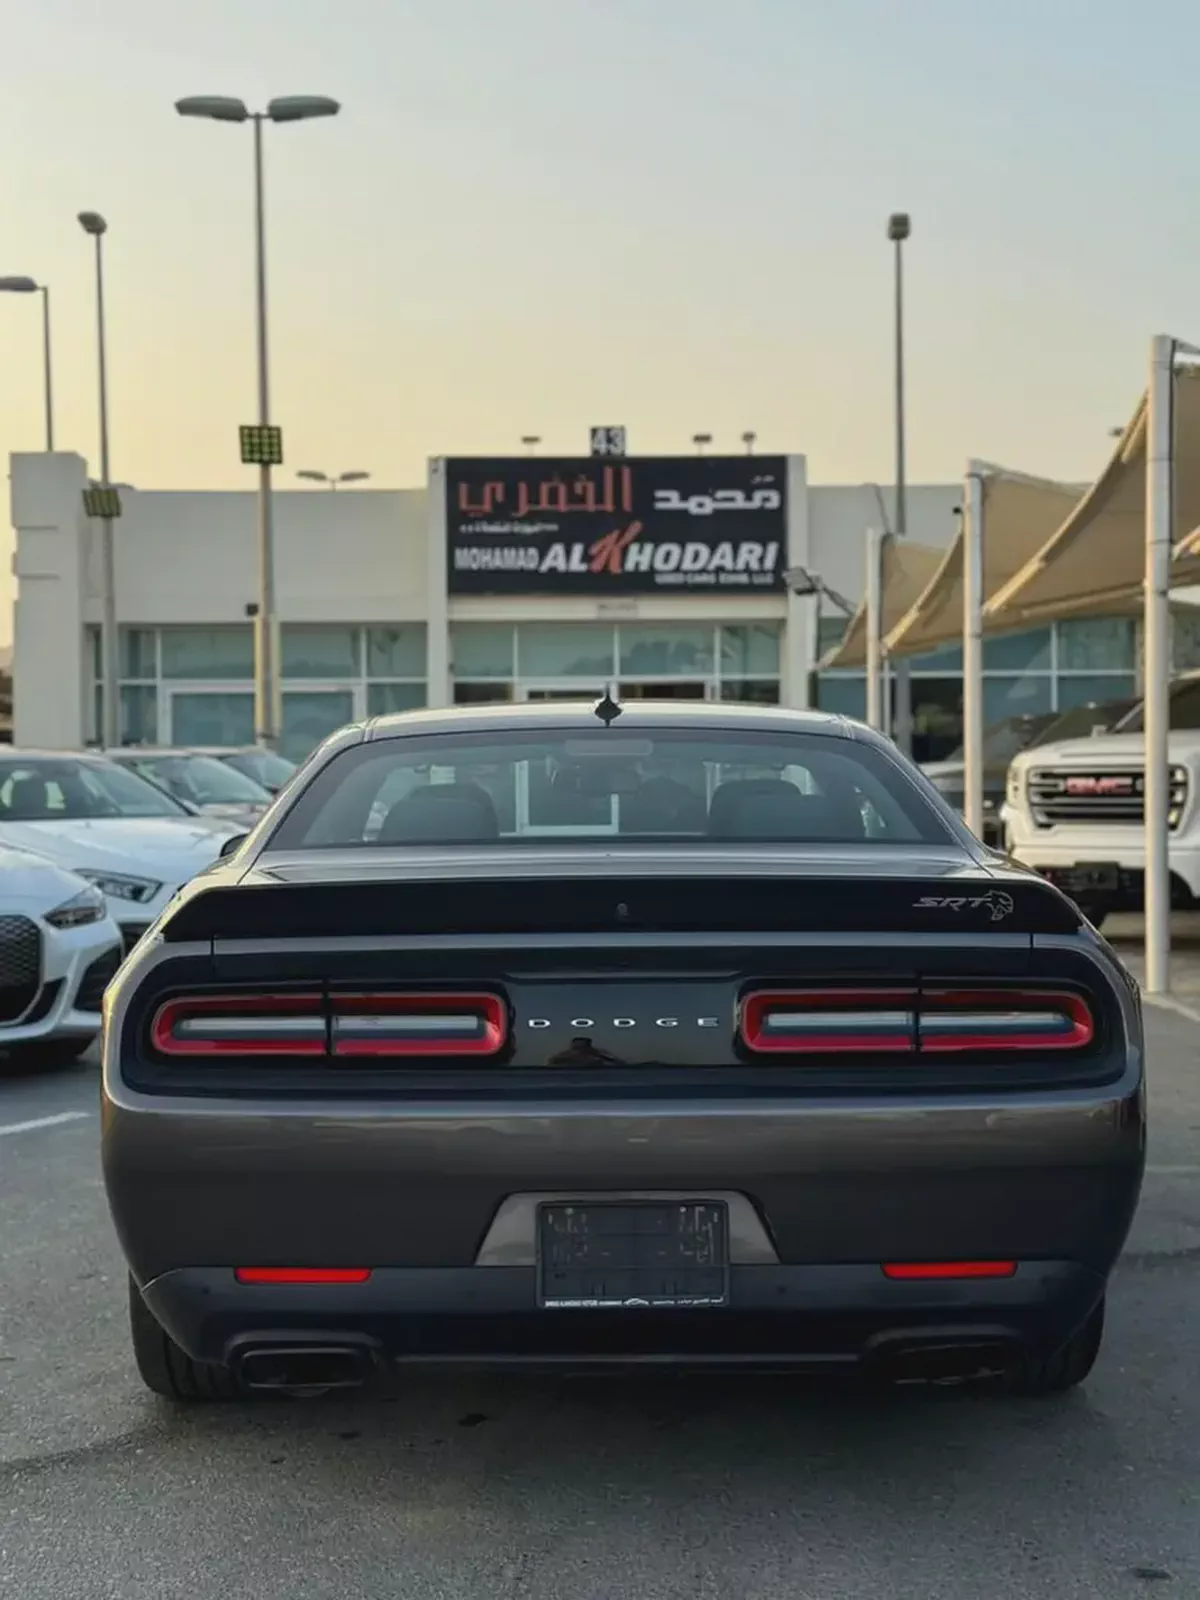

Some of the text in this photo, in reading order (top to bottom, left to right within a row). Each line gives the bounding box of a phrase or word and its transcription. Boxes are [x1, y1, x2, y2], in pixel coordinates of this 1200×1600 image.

[592, 428, 625, 455] 43
[458, 465, 781, 518] محمد الخضري
[454, 547, 540, 571] MOHAMAD
[1066, 777, 1132, 795] GMC
[912, 896, 992, 912] SRT
[528, 1017, 720, 1028] DODGE
